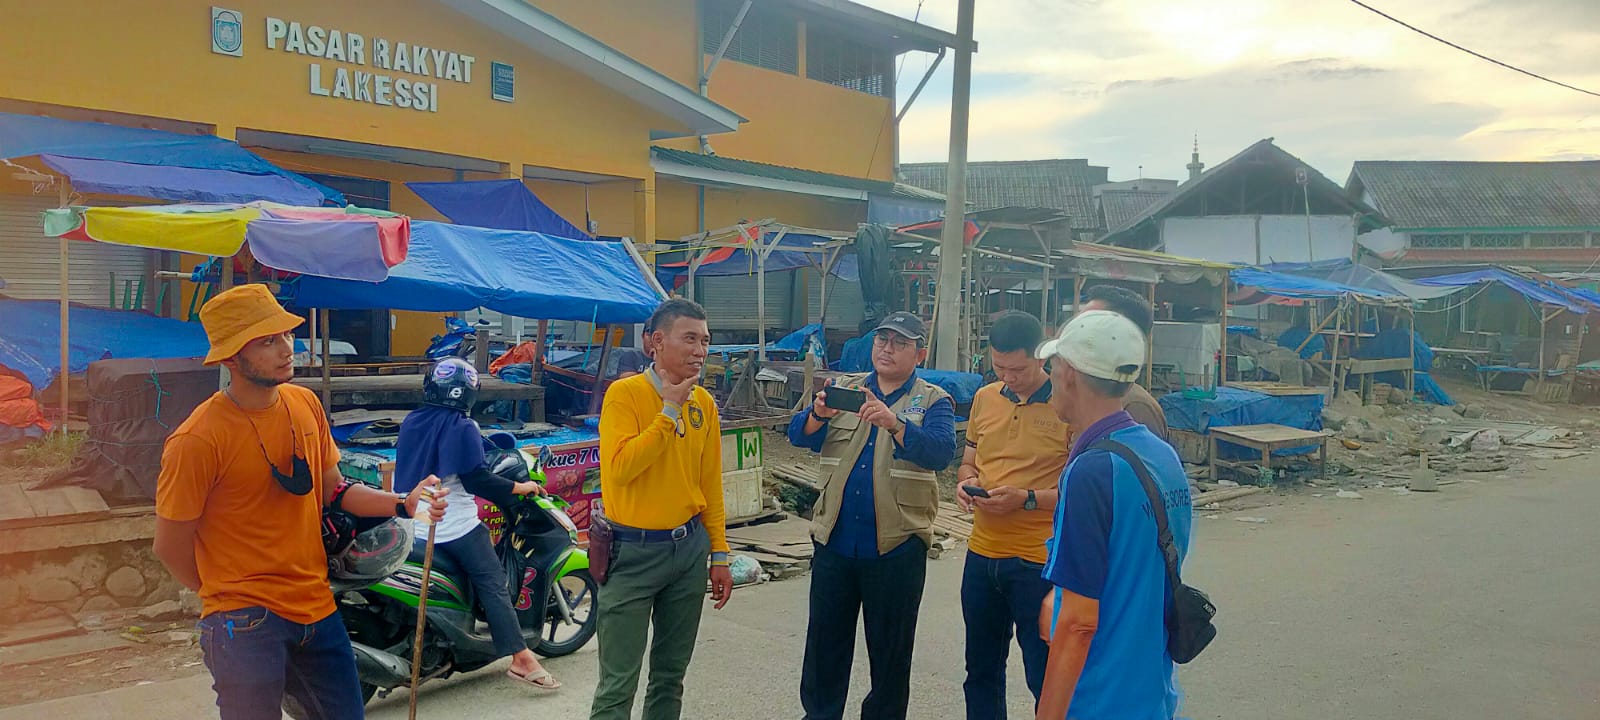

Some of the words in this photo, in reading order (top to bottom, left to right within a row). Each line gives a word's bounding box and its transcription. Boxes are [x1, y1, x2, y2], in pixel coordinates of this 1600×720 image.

[265, 16, 365, 65] PASAR
[372, 37, 475, 83] RAKYAT
[309, 63, 437, 112] LAKESSI
[547, 452, 577, 469] kue
[579, 447, 590, 465] 7
[1169, 488, 1192, 508] SORE
